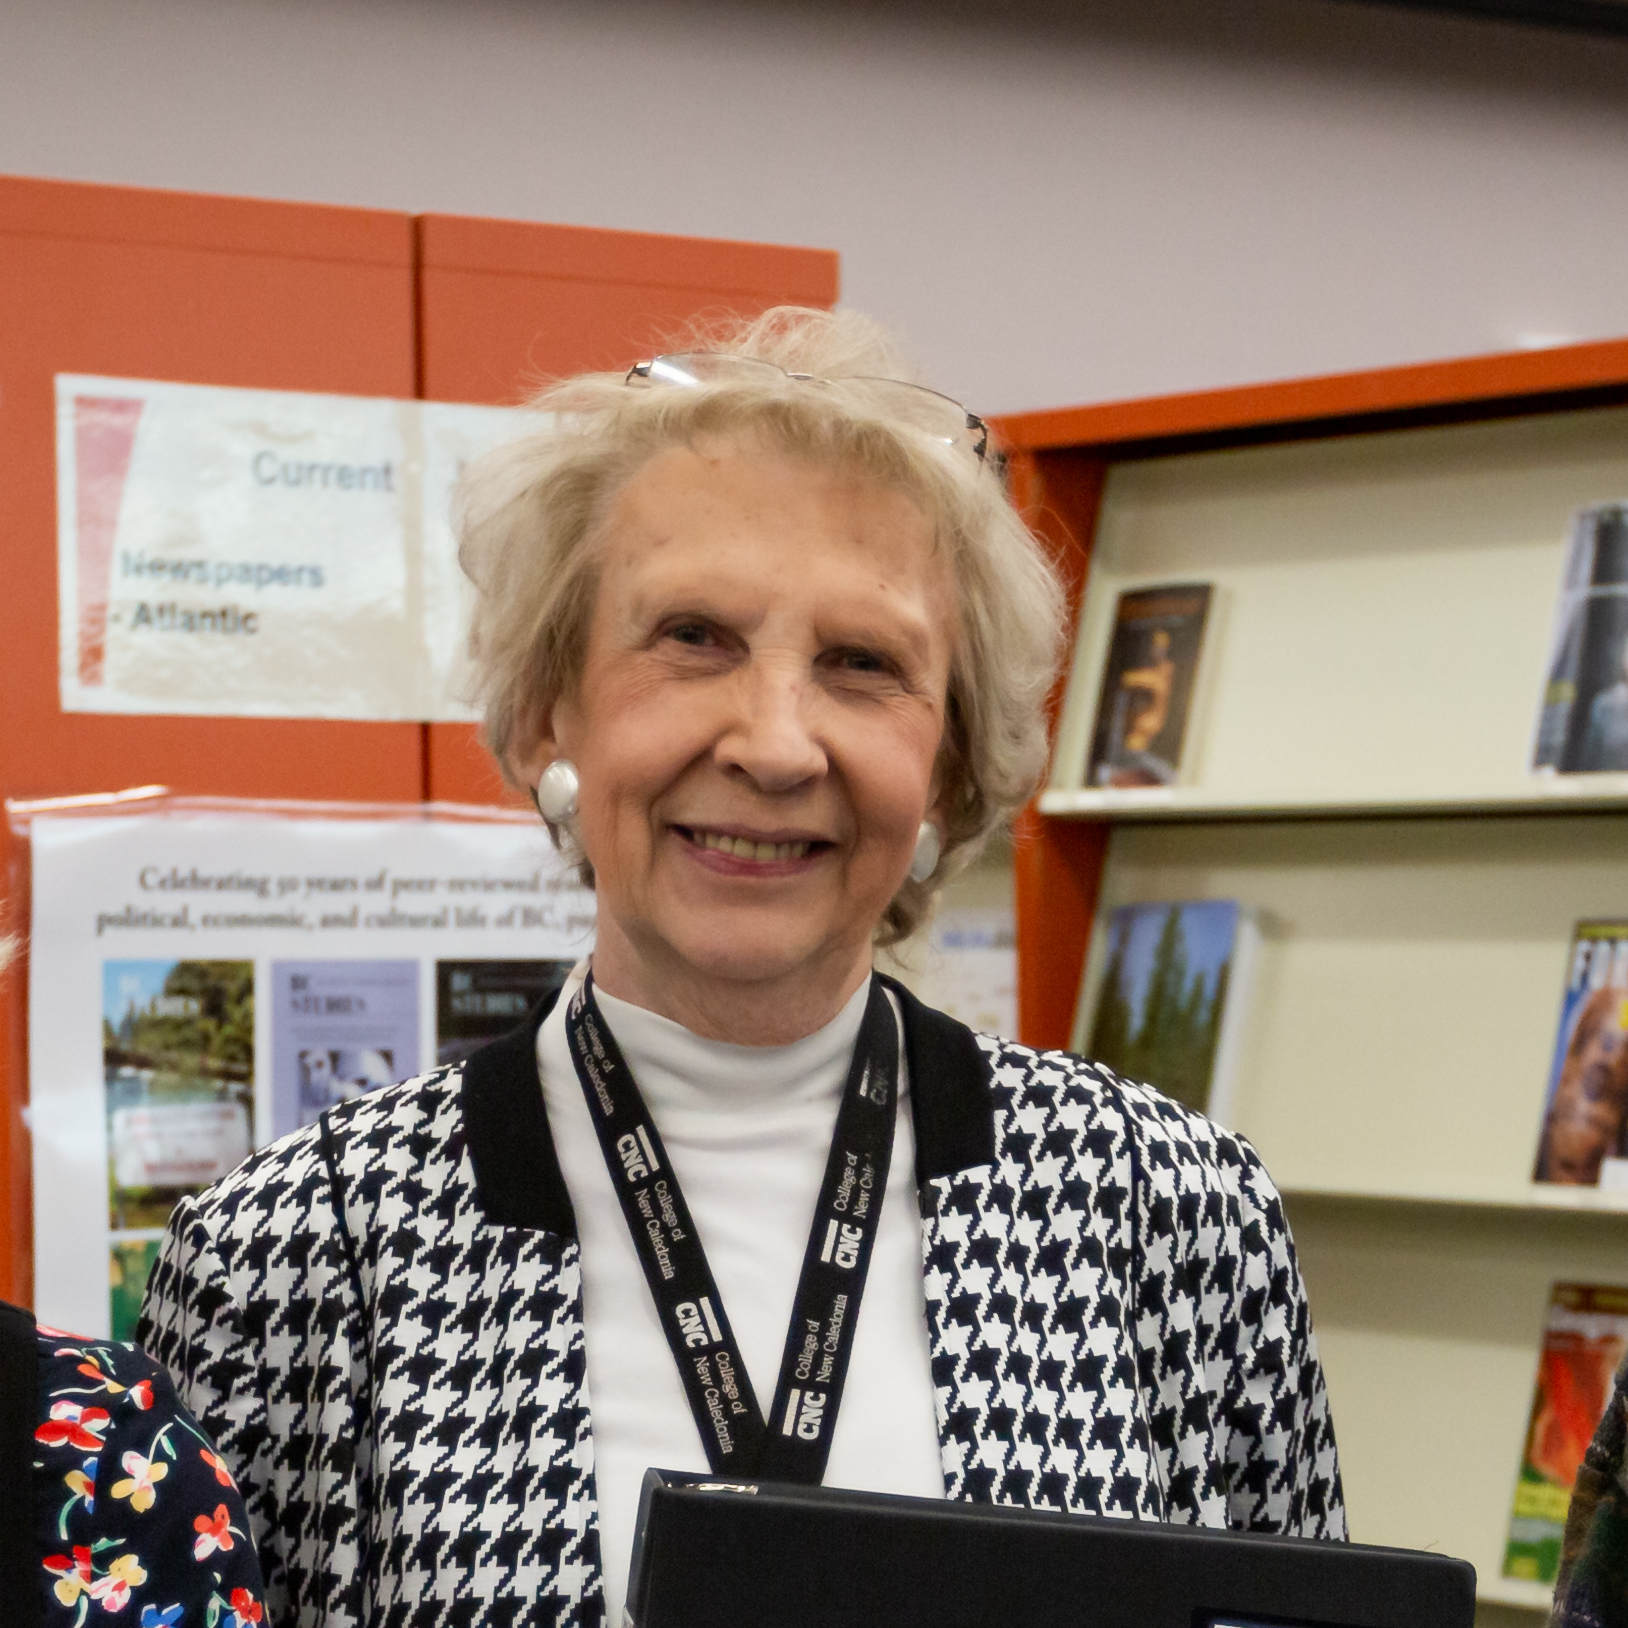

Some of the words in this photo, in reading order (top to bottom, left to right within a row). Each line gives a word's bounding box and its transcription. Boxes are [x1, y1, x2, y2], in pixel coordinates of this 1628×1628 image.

[252, 450, 395, 491] Current
[121, 549, 325, 589] Newspapers
[130, 601, 259, 635] Atlantic
[139, 866, 270, 899] Celebrating
[307, 877, 357, 899] years
[365, 869, 387, 891] of
[391, 870, 541, 898] peer-reviewed
[96, 904, 195, 936] political,
[201, 907, 313, 931] economic,
[320, 905, 358, 928] and
[365, 905, 449, 928] cultural
[455, 905, 488, 928] life
[495, 906, 514, 928] of
[585, 1014, 606, 1060] College
[603, 1060, 615, 1075] of
[575, 1026, 587, 1055] New
[584, 1054, 615, 1116] Caledonia
[617, 1133, 648, 1182] CNC
[834, 1167, 857, 1211] College
[846, 1152, 857, 1166] of
[853, 1190, 869, 1219] New
[635, 1188, 654, 1218] New
[647, 1220, 675, 1280] Caledonia
[654, 1180, 678, 1227] College
[671, 1228, 686, 1242] of
[835, 1224, 863, 1269] CNC
[676, 1302, 708, 1348] CNC
[806, 1319, 821, 1332] of
[824, 1294, 848, 1353] Caledonia
[795, 1335, 819, 1380] College
[816, 1354, 835, 1383] New
[693, 1356, 712, 1385] New
[705, 1389, 734, 1454] Caledonia
[715, 1352, 739, 1399] College
[731, 1402, 747, 1414] of
[797, 1391, 827, 1440] CNC
